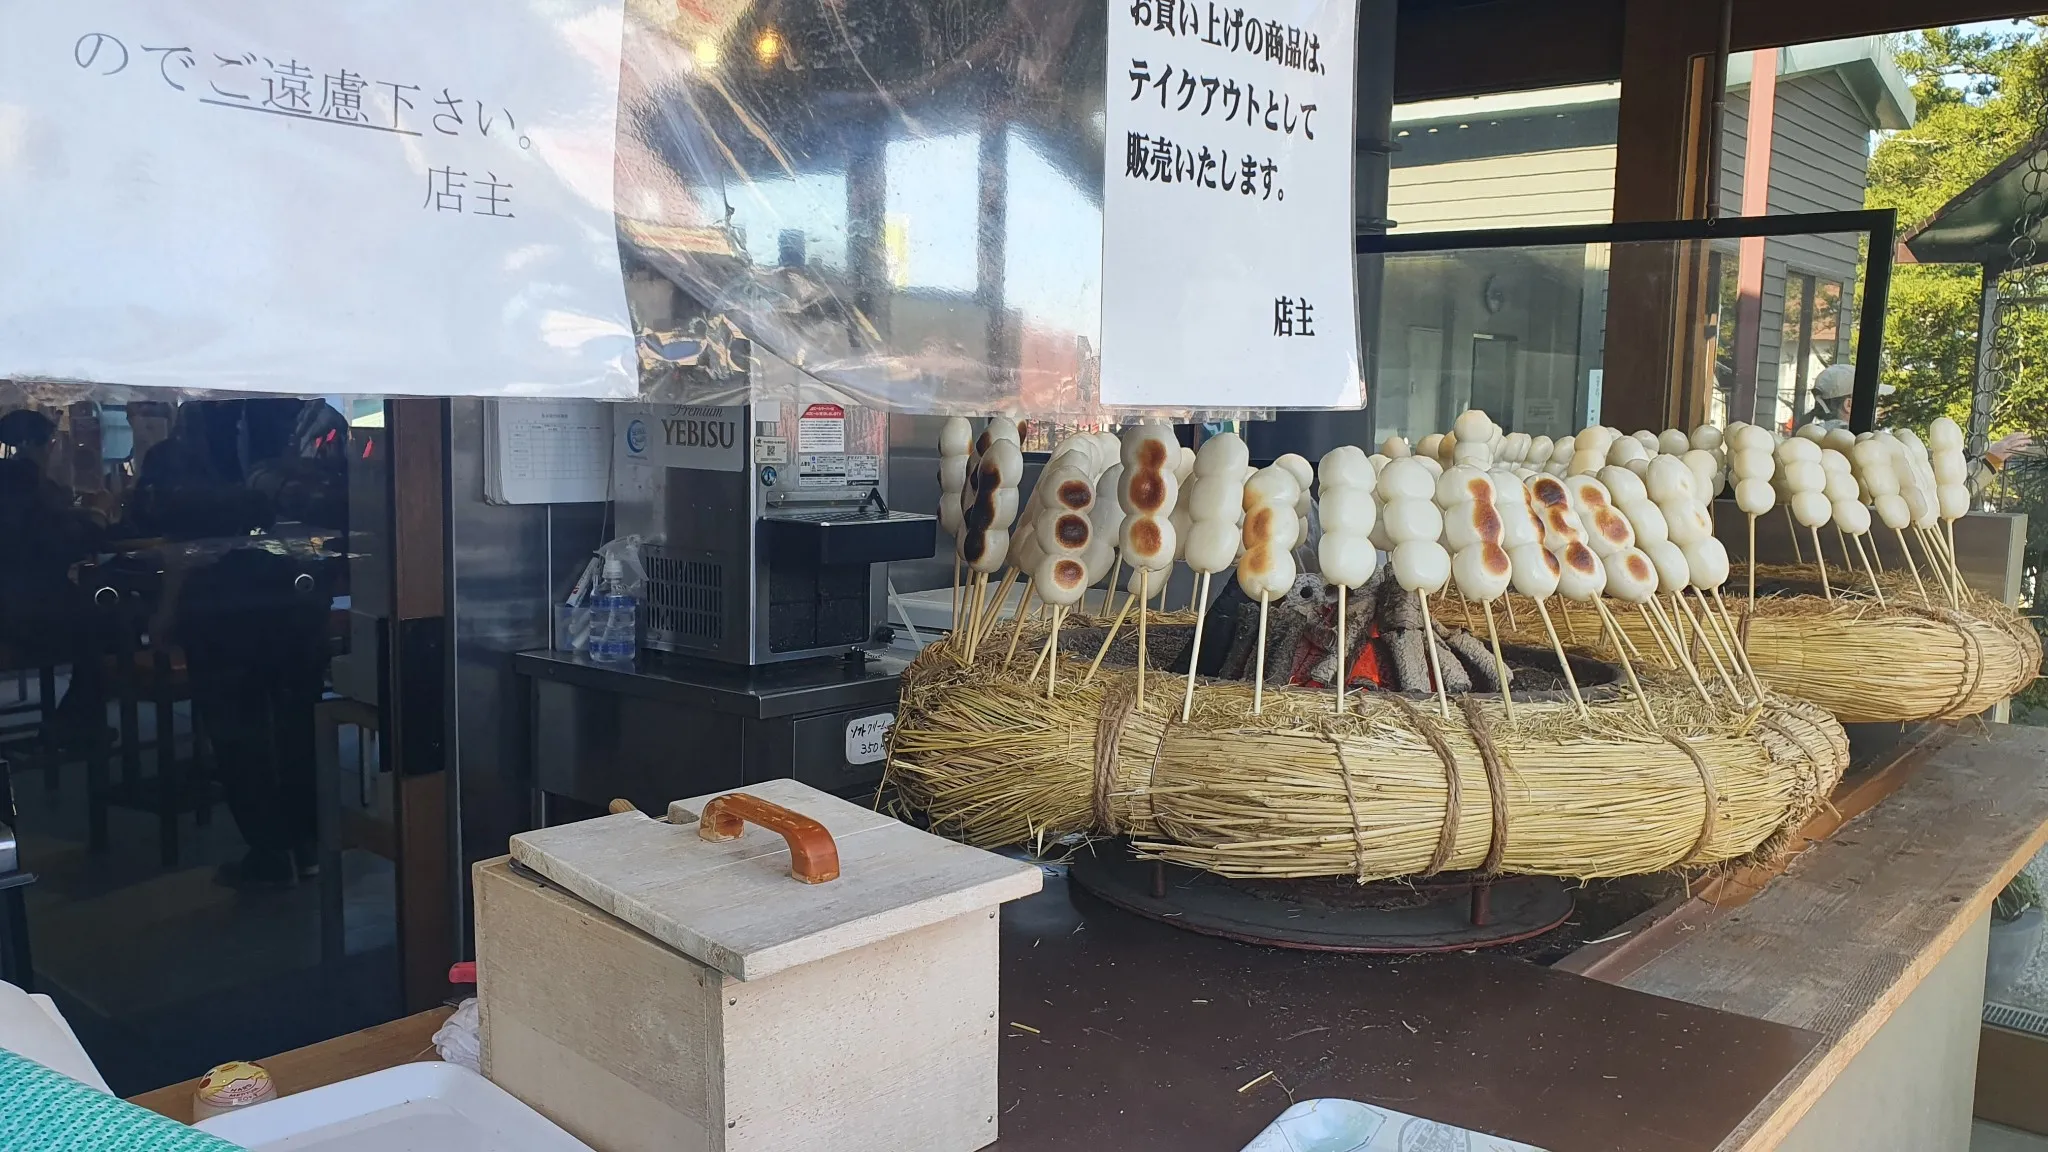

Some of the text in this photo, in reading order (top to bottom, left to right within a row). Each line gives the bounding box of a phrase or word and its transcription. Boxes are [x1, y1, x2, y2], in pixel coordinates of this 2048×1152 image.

[1130, 0, 1325, 76] お買い上げの商品は、
[74, 32, 531, 151] のでご遠慮下さい。
[1128, 58, 1318, 140] テイクアウトとして
[423, 165, 516, 219] 店主
[1125, 130, 1285, 202] 販売いたします。
[1273, 296, 1315, 338] 店主
[661, 418, 736, 450] YEBISU
[671, 403, 724, 418] Premium
